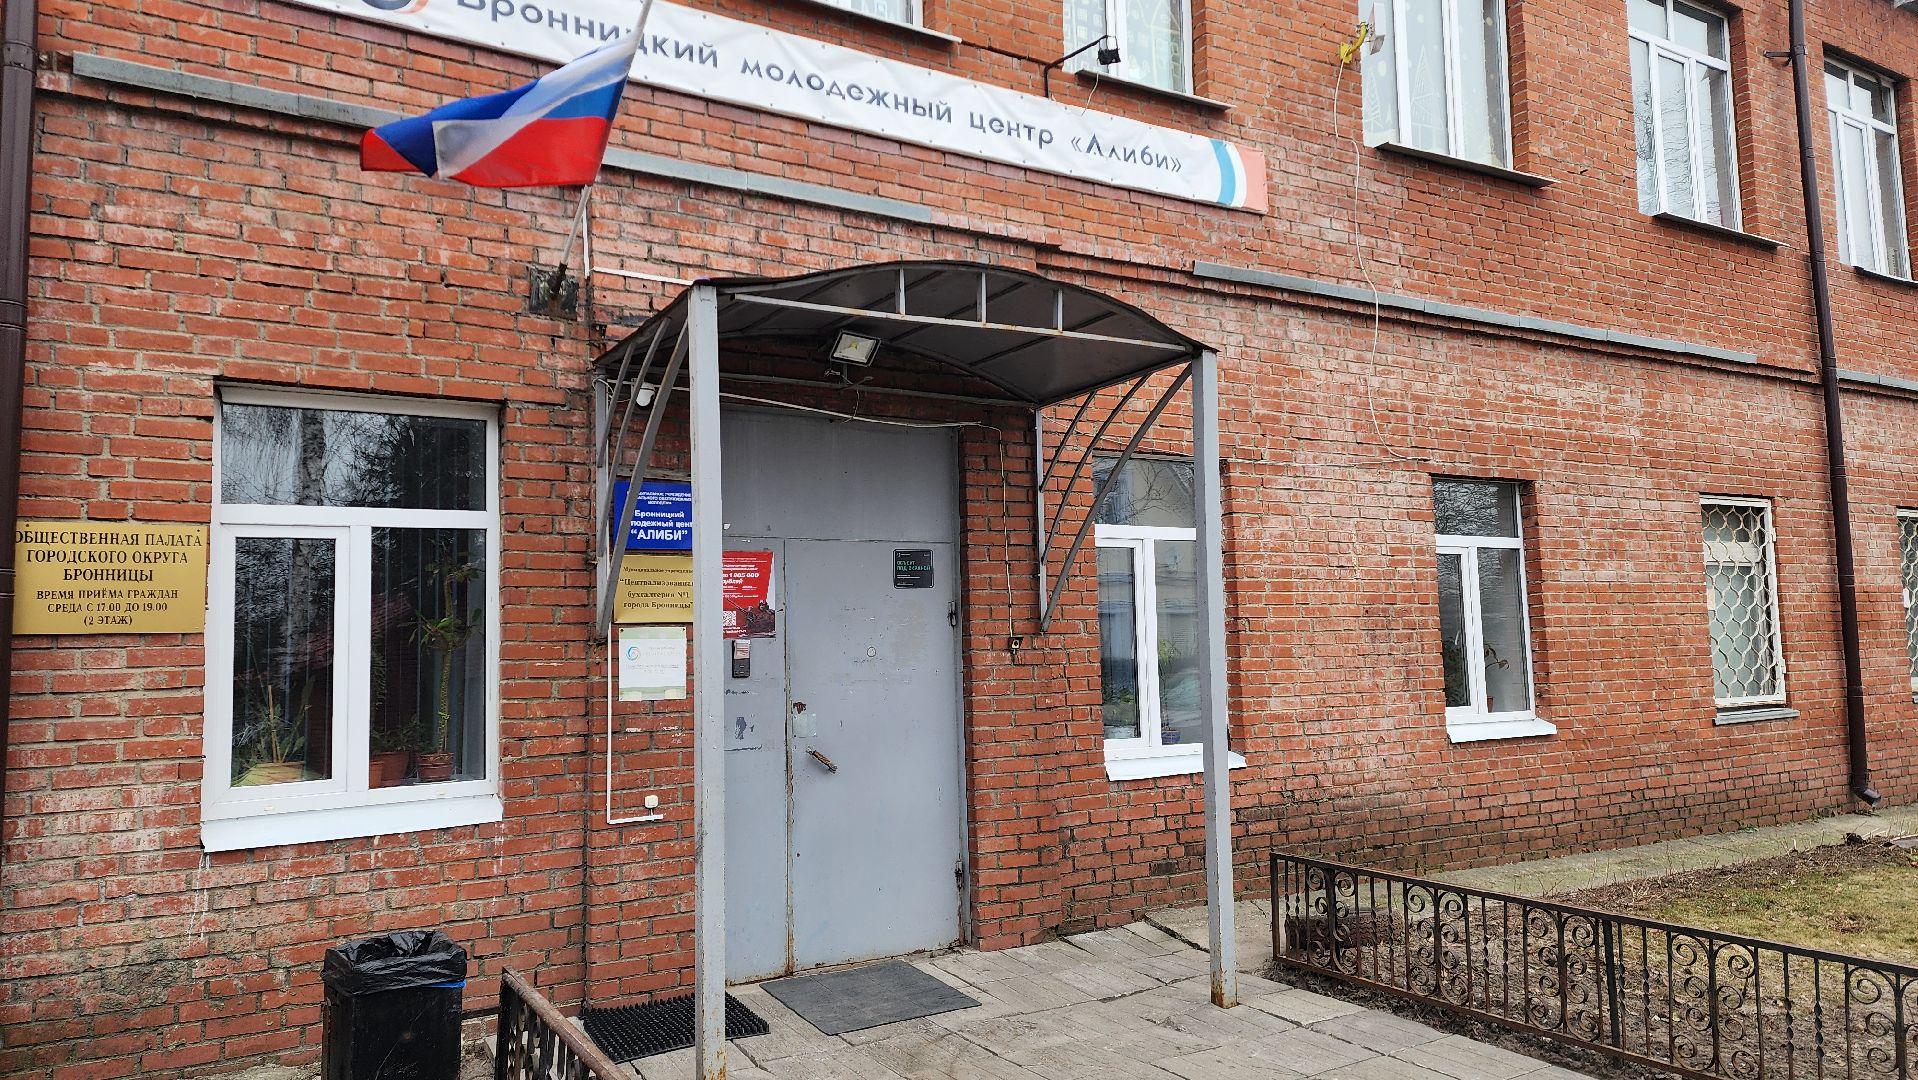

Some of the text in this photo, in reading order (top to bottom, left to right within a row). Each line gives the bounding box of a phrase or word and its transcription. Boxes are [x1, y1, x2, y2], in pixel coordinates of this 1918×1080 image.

[740, 57, 952, 123] молодежный
[969, 112, 1054, 150] центр
[1071, 133, 1182, 173] «Алиби»
[634, 509, 685, 518] Бронницкий
[16, 531, 202, 547] ОБЩЕСТВЕННАЯ ПАЛАТА
[26, 550, 188, 564] ГОРОДСКОГО ОКРУГА
[63, 568, 153, 582] БРОННИЦЫ
[37, 587, 179, 600] ВРЕМЯ ПРИЁМА ГРАЖДАН
[627, 590, 675, 599] бухгалтерия
[47, 602, 168, 614] СРЕДА С 17.00 ДО 19.00
[83, 615, 133, 626] (2 ЭТАЖ)
